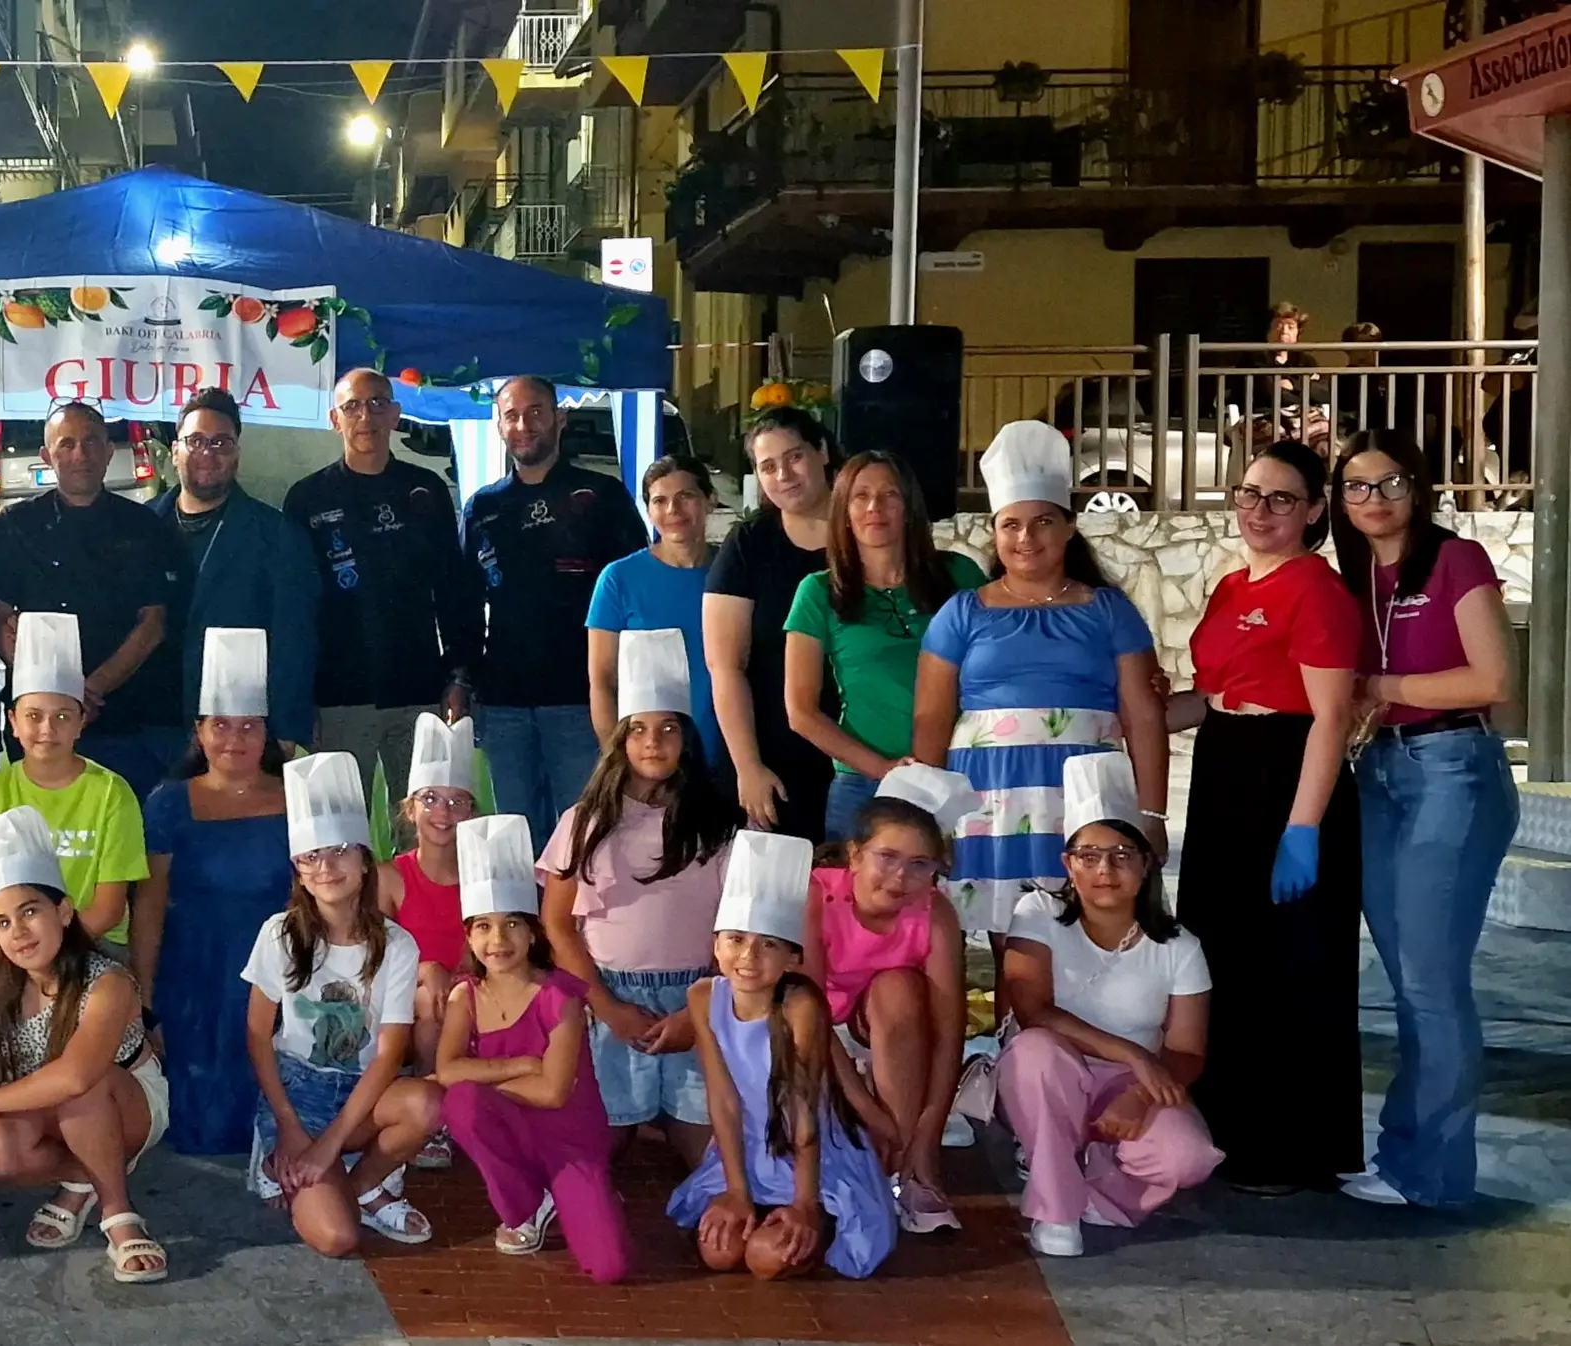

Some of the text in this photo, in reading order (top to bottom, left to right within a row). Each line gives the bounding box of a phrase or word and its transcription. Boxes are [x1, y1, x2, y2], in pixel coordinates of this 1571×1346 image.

[1469, 27, 1571, 99] Associazio
[163, 328, 223, 341] CALABRIA
[45, 357, 282, 410] GIURIA
